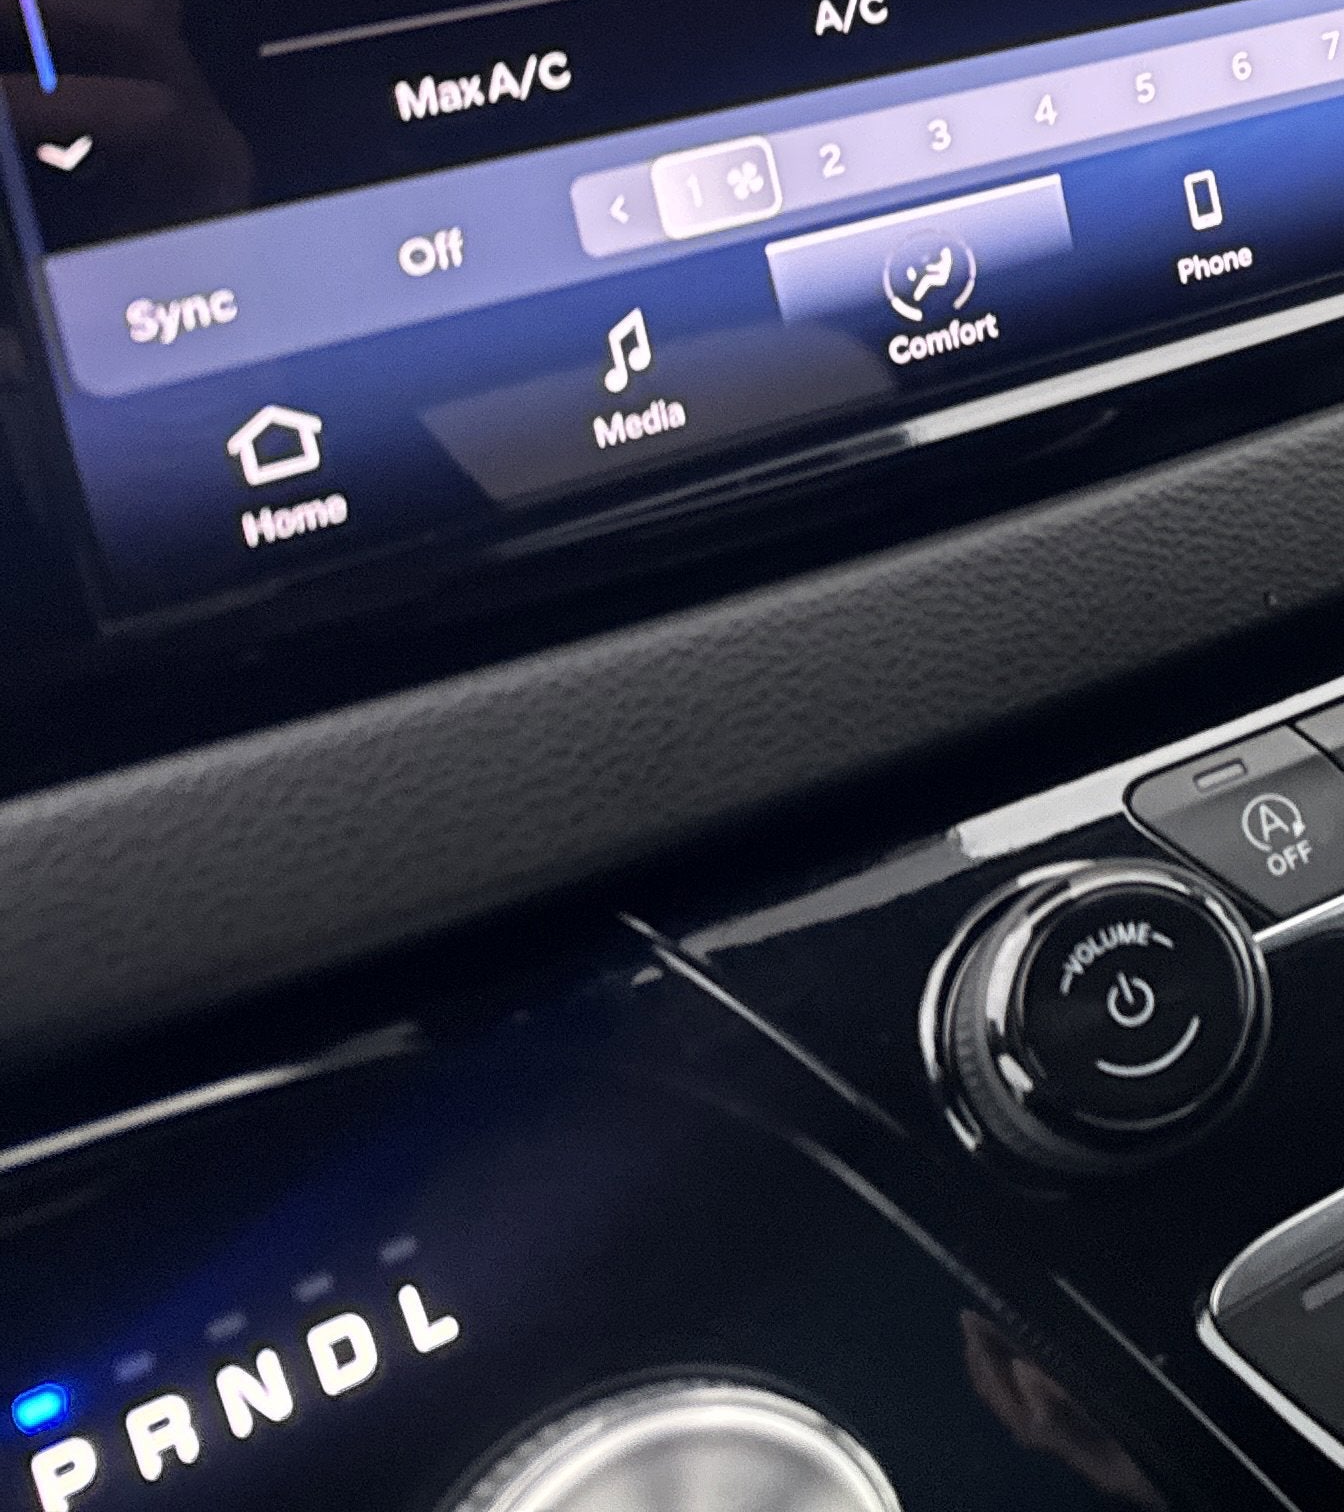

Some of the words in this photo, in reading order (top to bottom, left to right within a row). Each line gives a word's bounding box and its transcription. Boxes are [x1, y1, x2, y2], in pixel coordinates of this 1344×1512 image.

[1322, 31, 1341, 61] 7
[1231, 51, 1252, 82] 6
[1134, 72, 1157, 104] 5
[1033, 94, 1058, 128] 4
[927, 119, 953, 152] 3
[820, 144, 845, 178] 2
[398, 226, 465, 278] Off
[1178, 245, 1253, 285] Phone
[125, 288, 238, 346] Sync
[888, 310, 999, 366] Comfort
[593, 397, 686, 449] Media
[240, 491, 349, 550] Home
[1266, 840, 1314, 878] OFF
[1062, 921, 1153, 976] VOLUME
[30, 1435, 96, 1511] P
